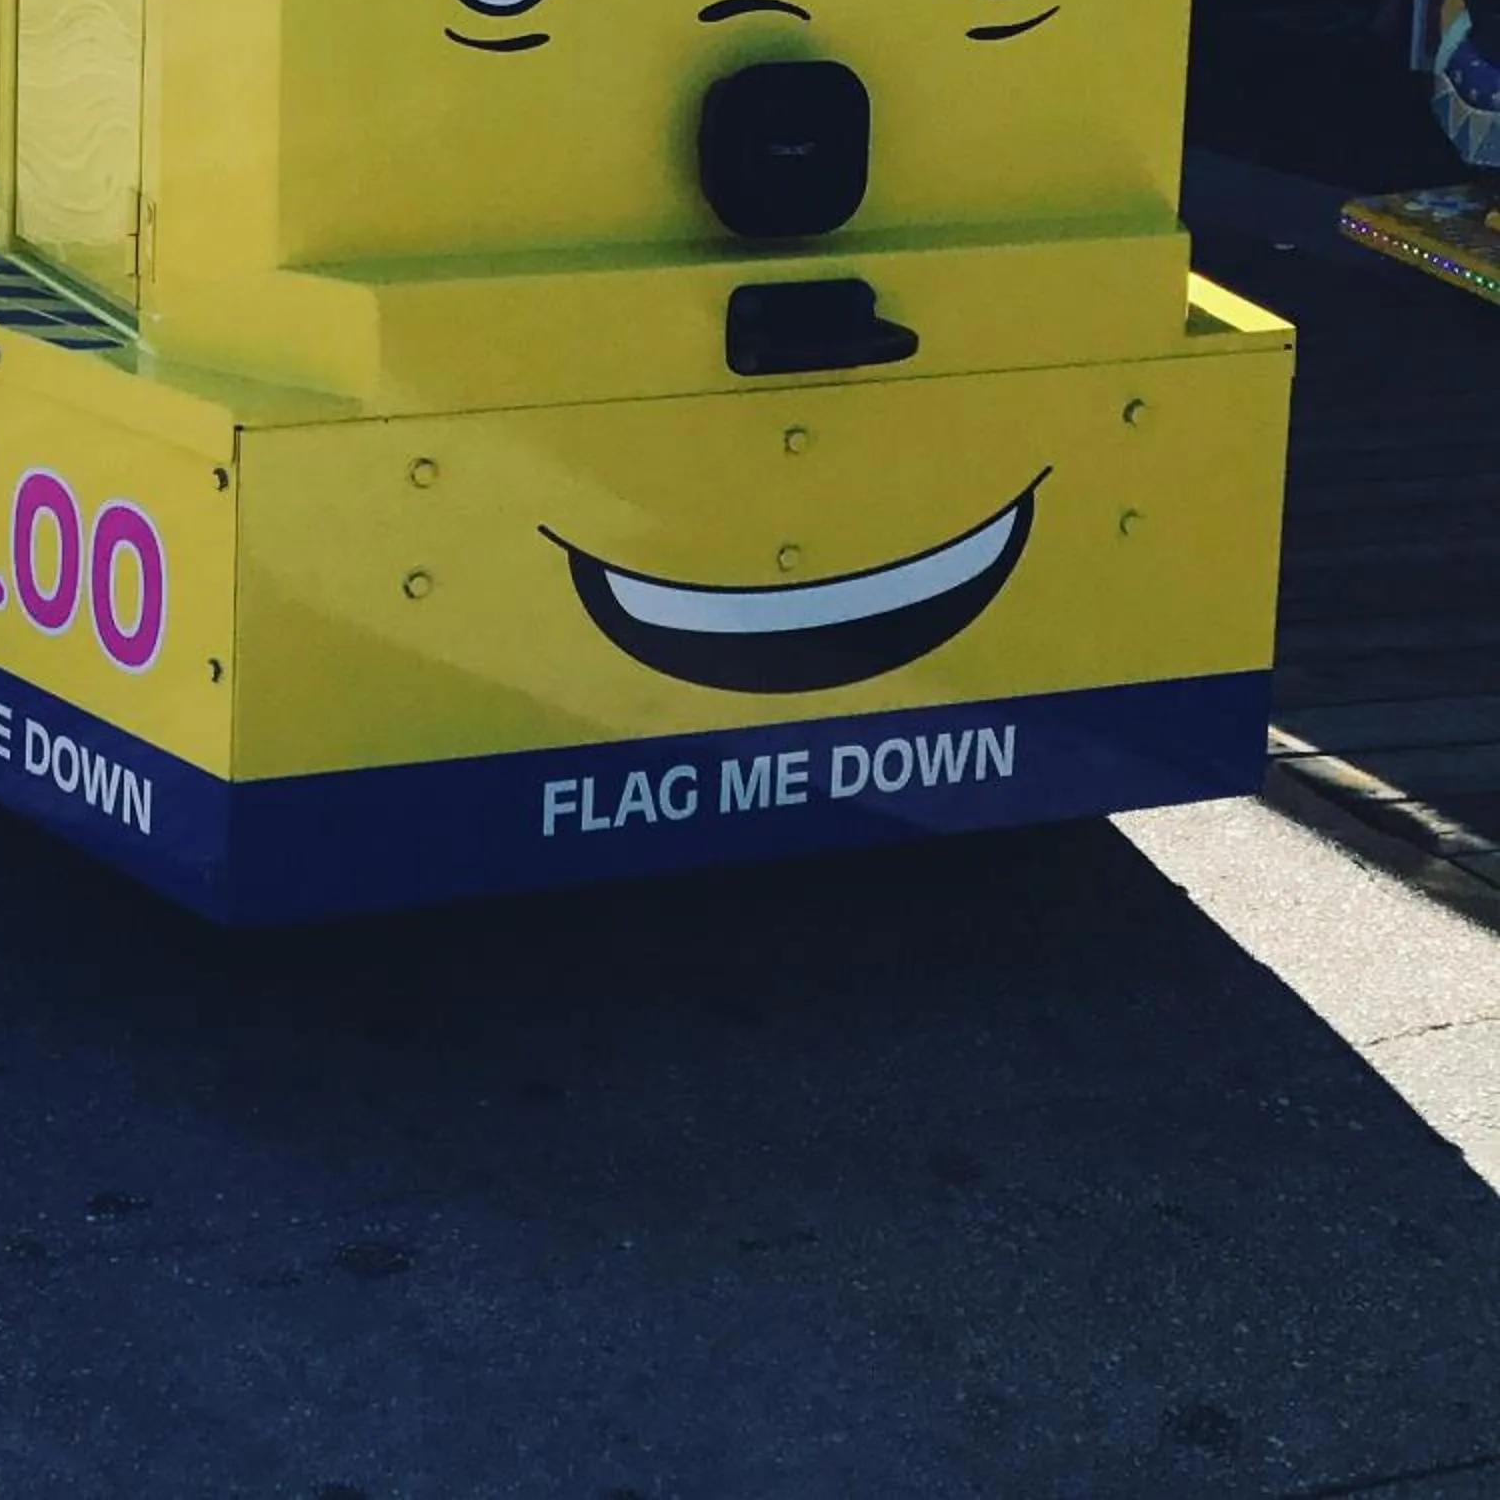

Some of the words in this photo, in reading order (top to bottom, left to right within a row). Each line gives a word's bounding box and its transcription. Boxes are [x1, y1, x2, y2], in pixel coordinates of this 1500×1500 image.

[25, 717, 153, 836] DOWN
[542, 764, 698, 837] FLAG
[719, 749, 810, 814] ME
[829, 724, 1017, 799] DOWN
